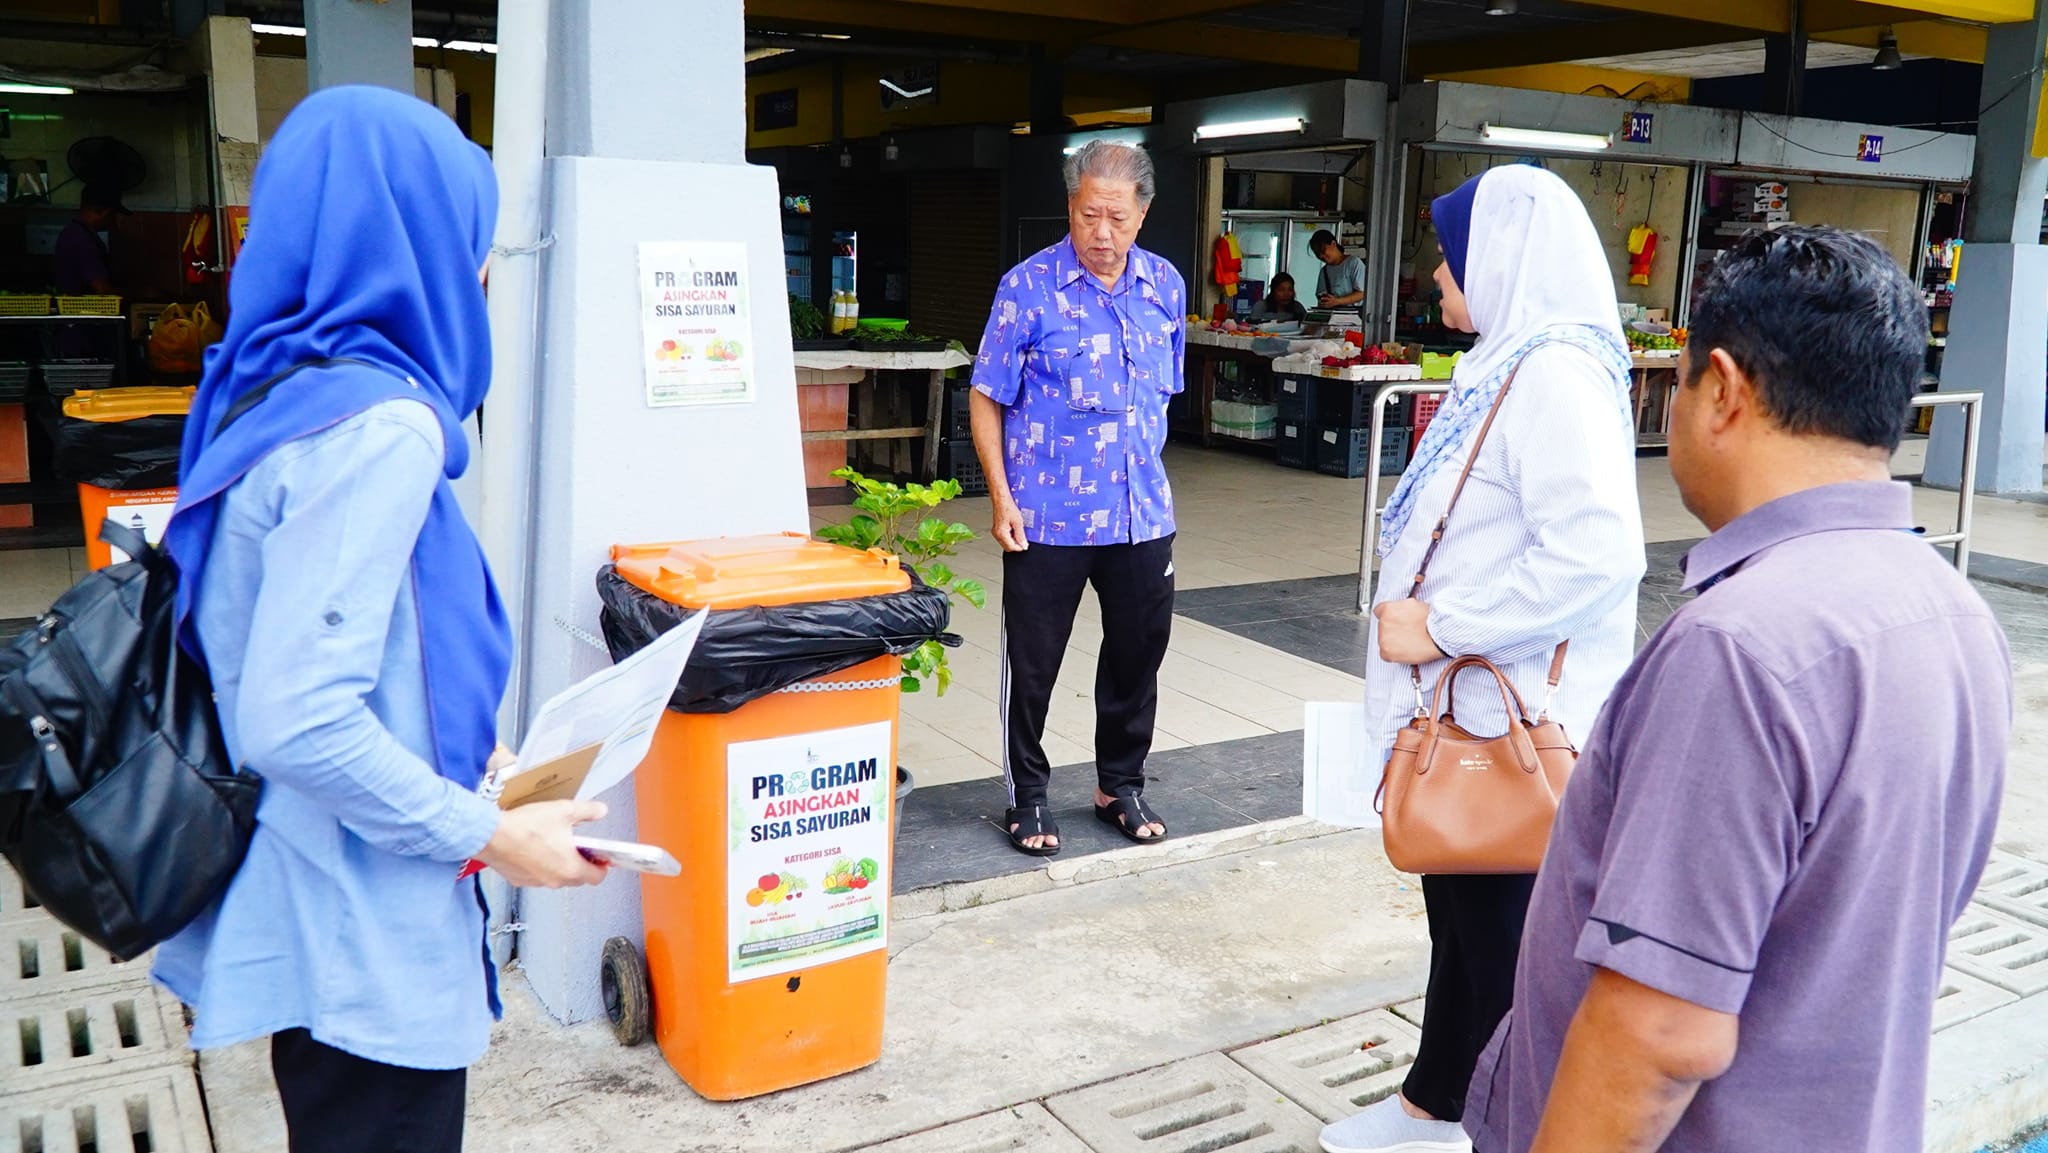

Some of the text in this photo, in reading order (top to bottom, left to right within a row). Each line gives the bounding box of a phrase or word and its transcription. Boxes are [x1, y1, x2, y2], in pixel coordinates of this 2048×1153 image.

[1631, 118, 1651, 138] P-13
[1864, 140, 1881, 158] P-14
[663, 290, 727, 301] ASINGKAN
[655, 303, 736, 317] SISA SAYURAN
[763, 788, 860, 820] ASINGKAN
[750, 806, 871, 843] SISA SAYURAN
[784, 846, 842, 865] KATEGORI SISA
